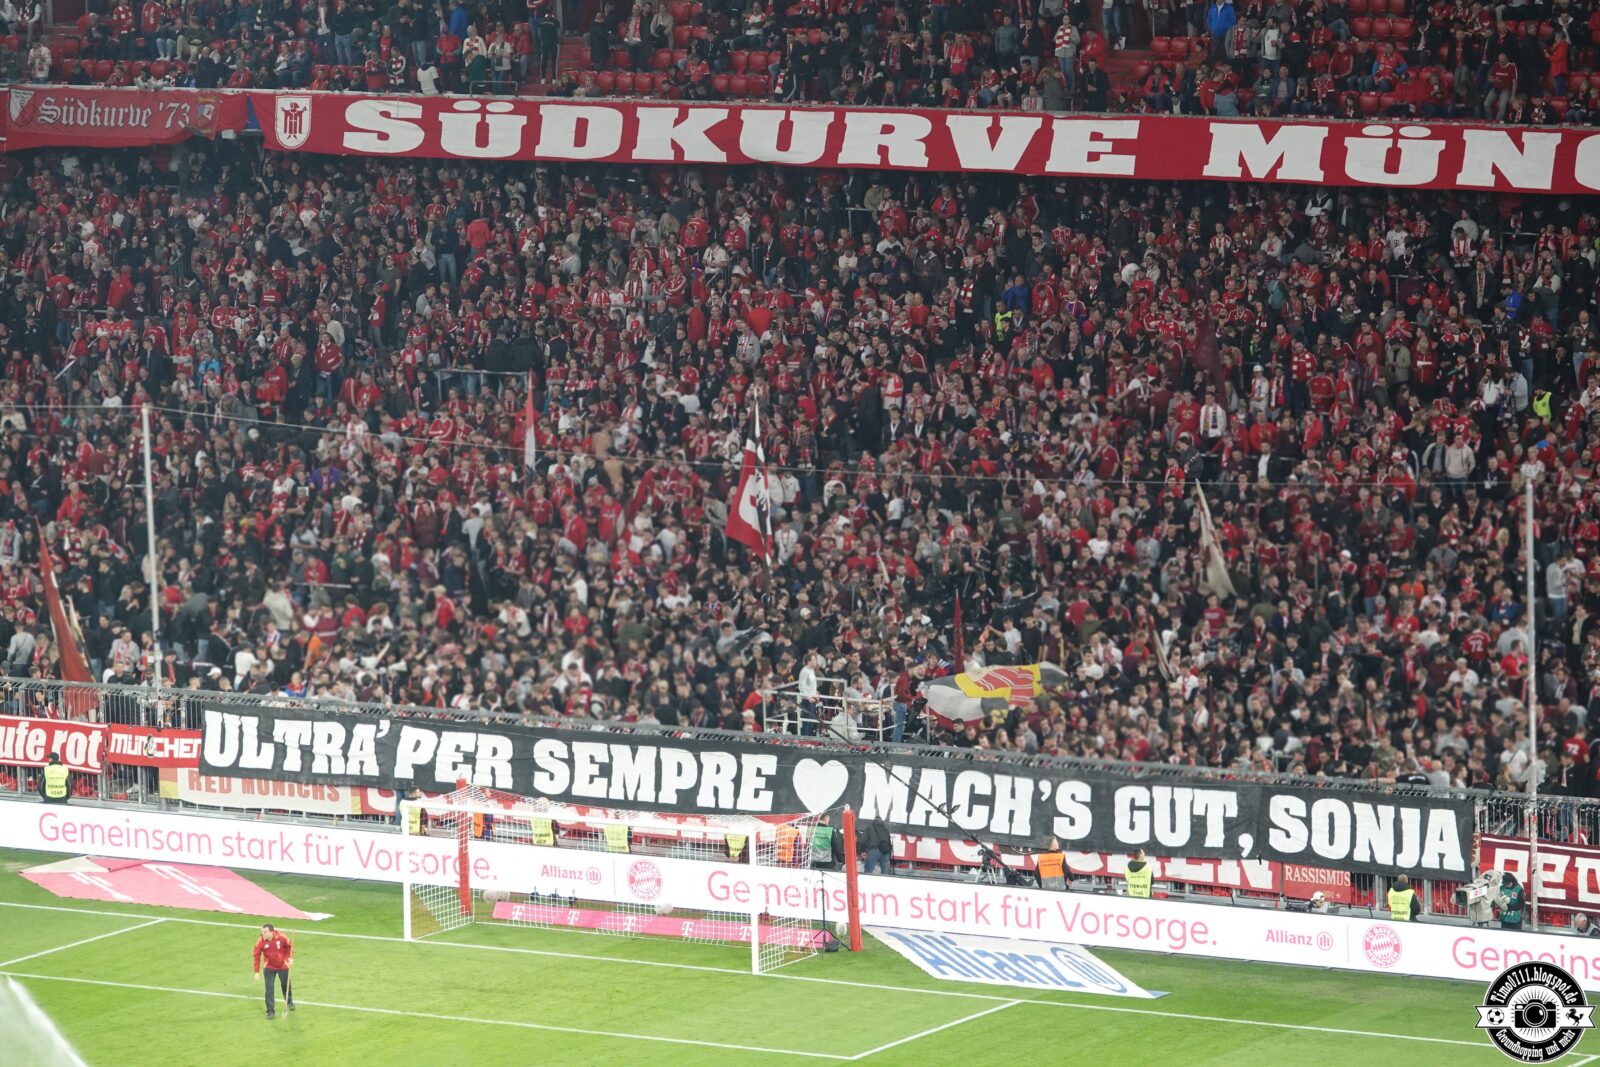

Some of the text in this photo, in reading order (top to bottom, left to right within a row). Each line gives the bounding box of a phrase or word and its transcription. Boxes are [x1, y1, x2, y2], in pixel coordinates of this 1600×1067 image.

[38, 96, 192, 129] Südkurve '73
[342, 98, 1600, 191] SÜDKURVE MÜN
[51, 729, 103, 769] rot
[188, 768, 232, 794] RED
[203, 710, 391, 776] ULTRA'
[394, 725, 514, 789] PER
[533, 738, 778, 812] SEMPRE
[858, 762, 1093, 841] MACH'S
[1113, 785, 1254, 858] GUT,
[1268, 794, 1465, 872] SONJA
[39, 812, 212, 855] Gemeinsam
[221, 831, 295, 862] stark
[303, 834, 345, 866] für
[541, 864, 584, 880] Allianz
[1284, 865, 1351, 887] RASSISMUS
[910, 892, 991, 926] stark
[1000, 895, 1047, 930] für
[1057, 901, 1218, 950] Vorsorge.
[1265, 929, 1313, 946] Allianz
[884, 931, 1087, 988] Allianz
